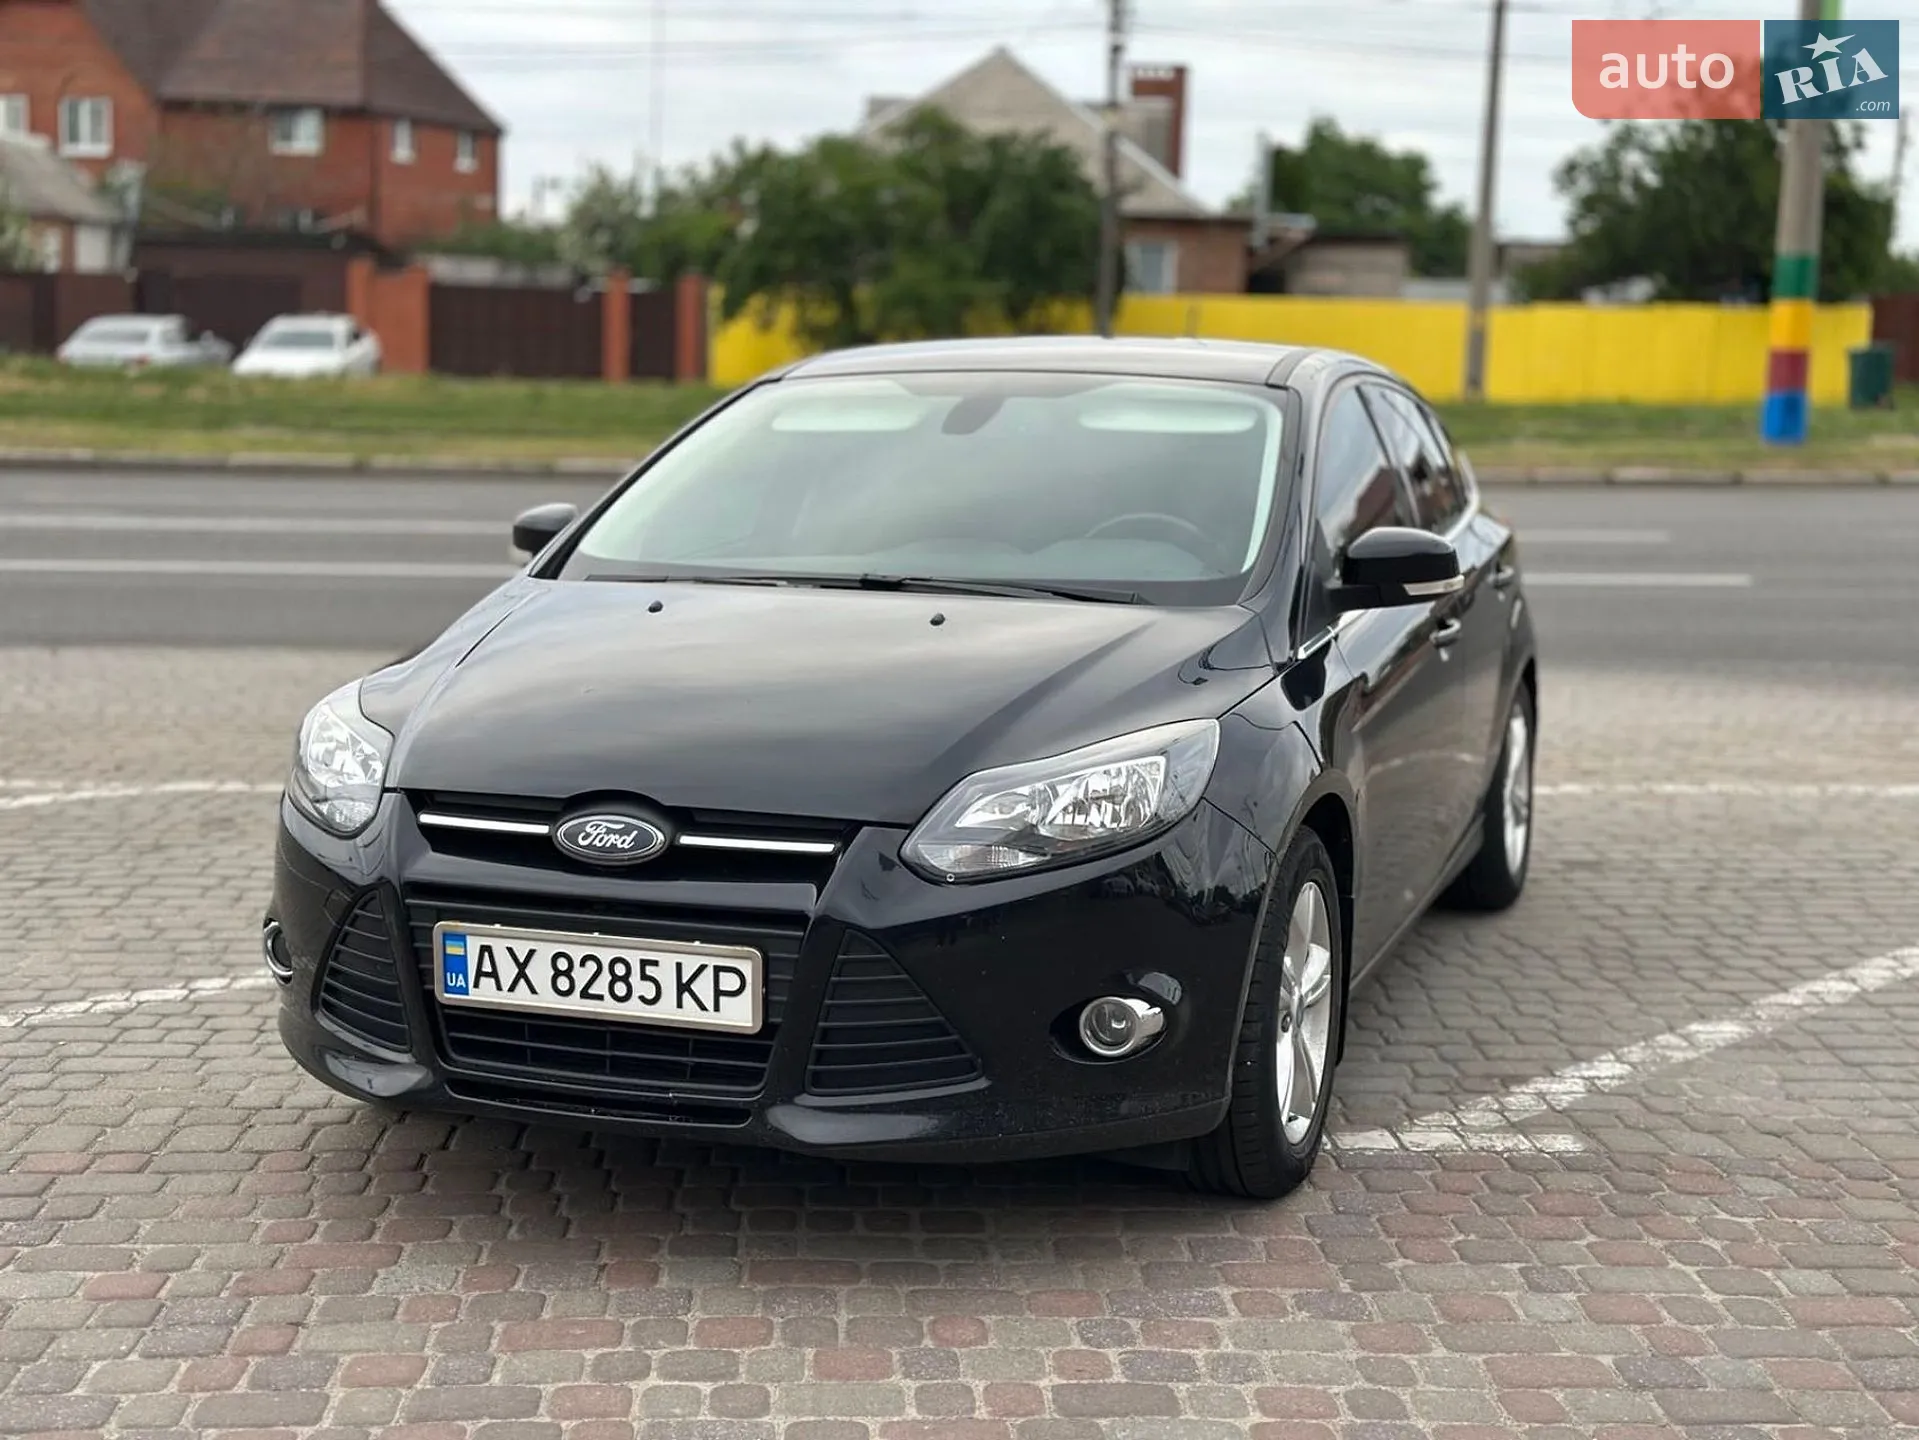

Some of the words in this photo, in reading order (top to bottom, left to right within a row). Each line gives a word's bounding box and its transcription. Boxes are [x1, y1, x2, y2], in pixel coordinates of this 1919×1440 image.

[578, 820, 638, 849] Ford
[447, 973, 467, 989] UA
[472, 944, 538, 995] AX
[550, 951, 662, 1006] 8285
[675, 963, 747, 1013] KP
